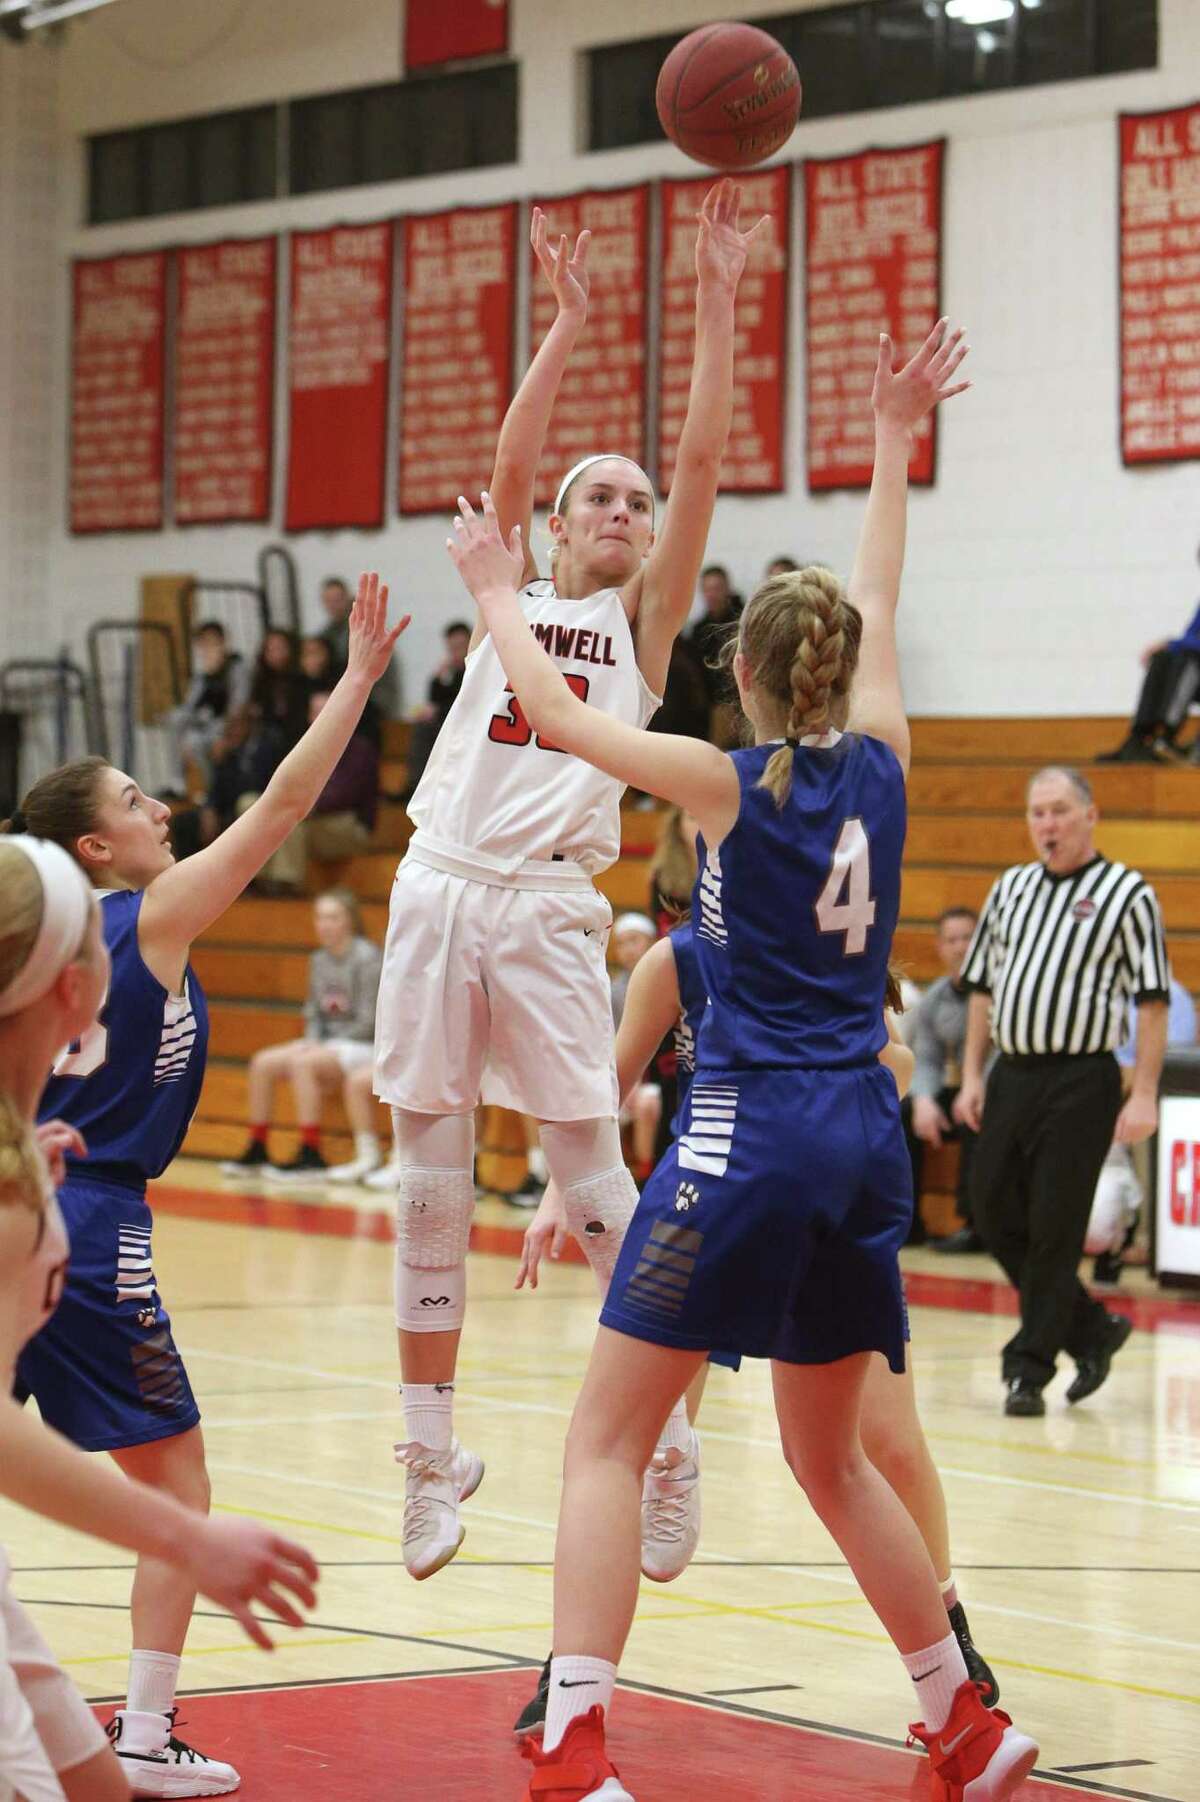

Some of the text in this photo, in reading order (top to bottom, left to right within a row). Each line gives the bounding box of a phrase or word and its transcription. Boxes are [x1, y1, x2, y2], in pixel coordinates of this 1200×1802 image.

[1134, 121, 1182, 156] ALL
[817, 164, 857, 198] ALL
[529, 622, 617, 667] MWELL
[814, 815, 877, 957] 4
